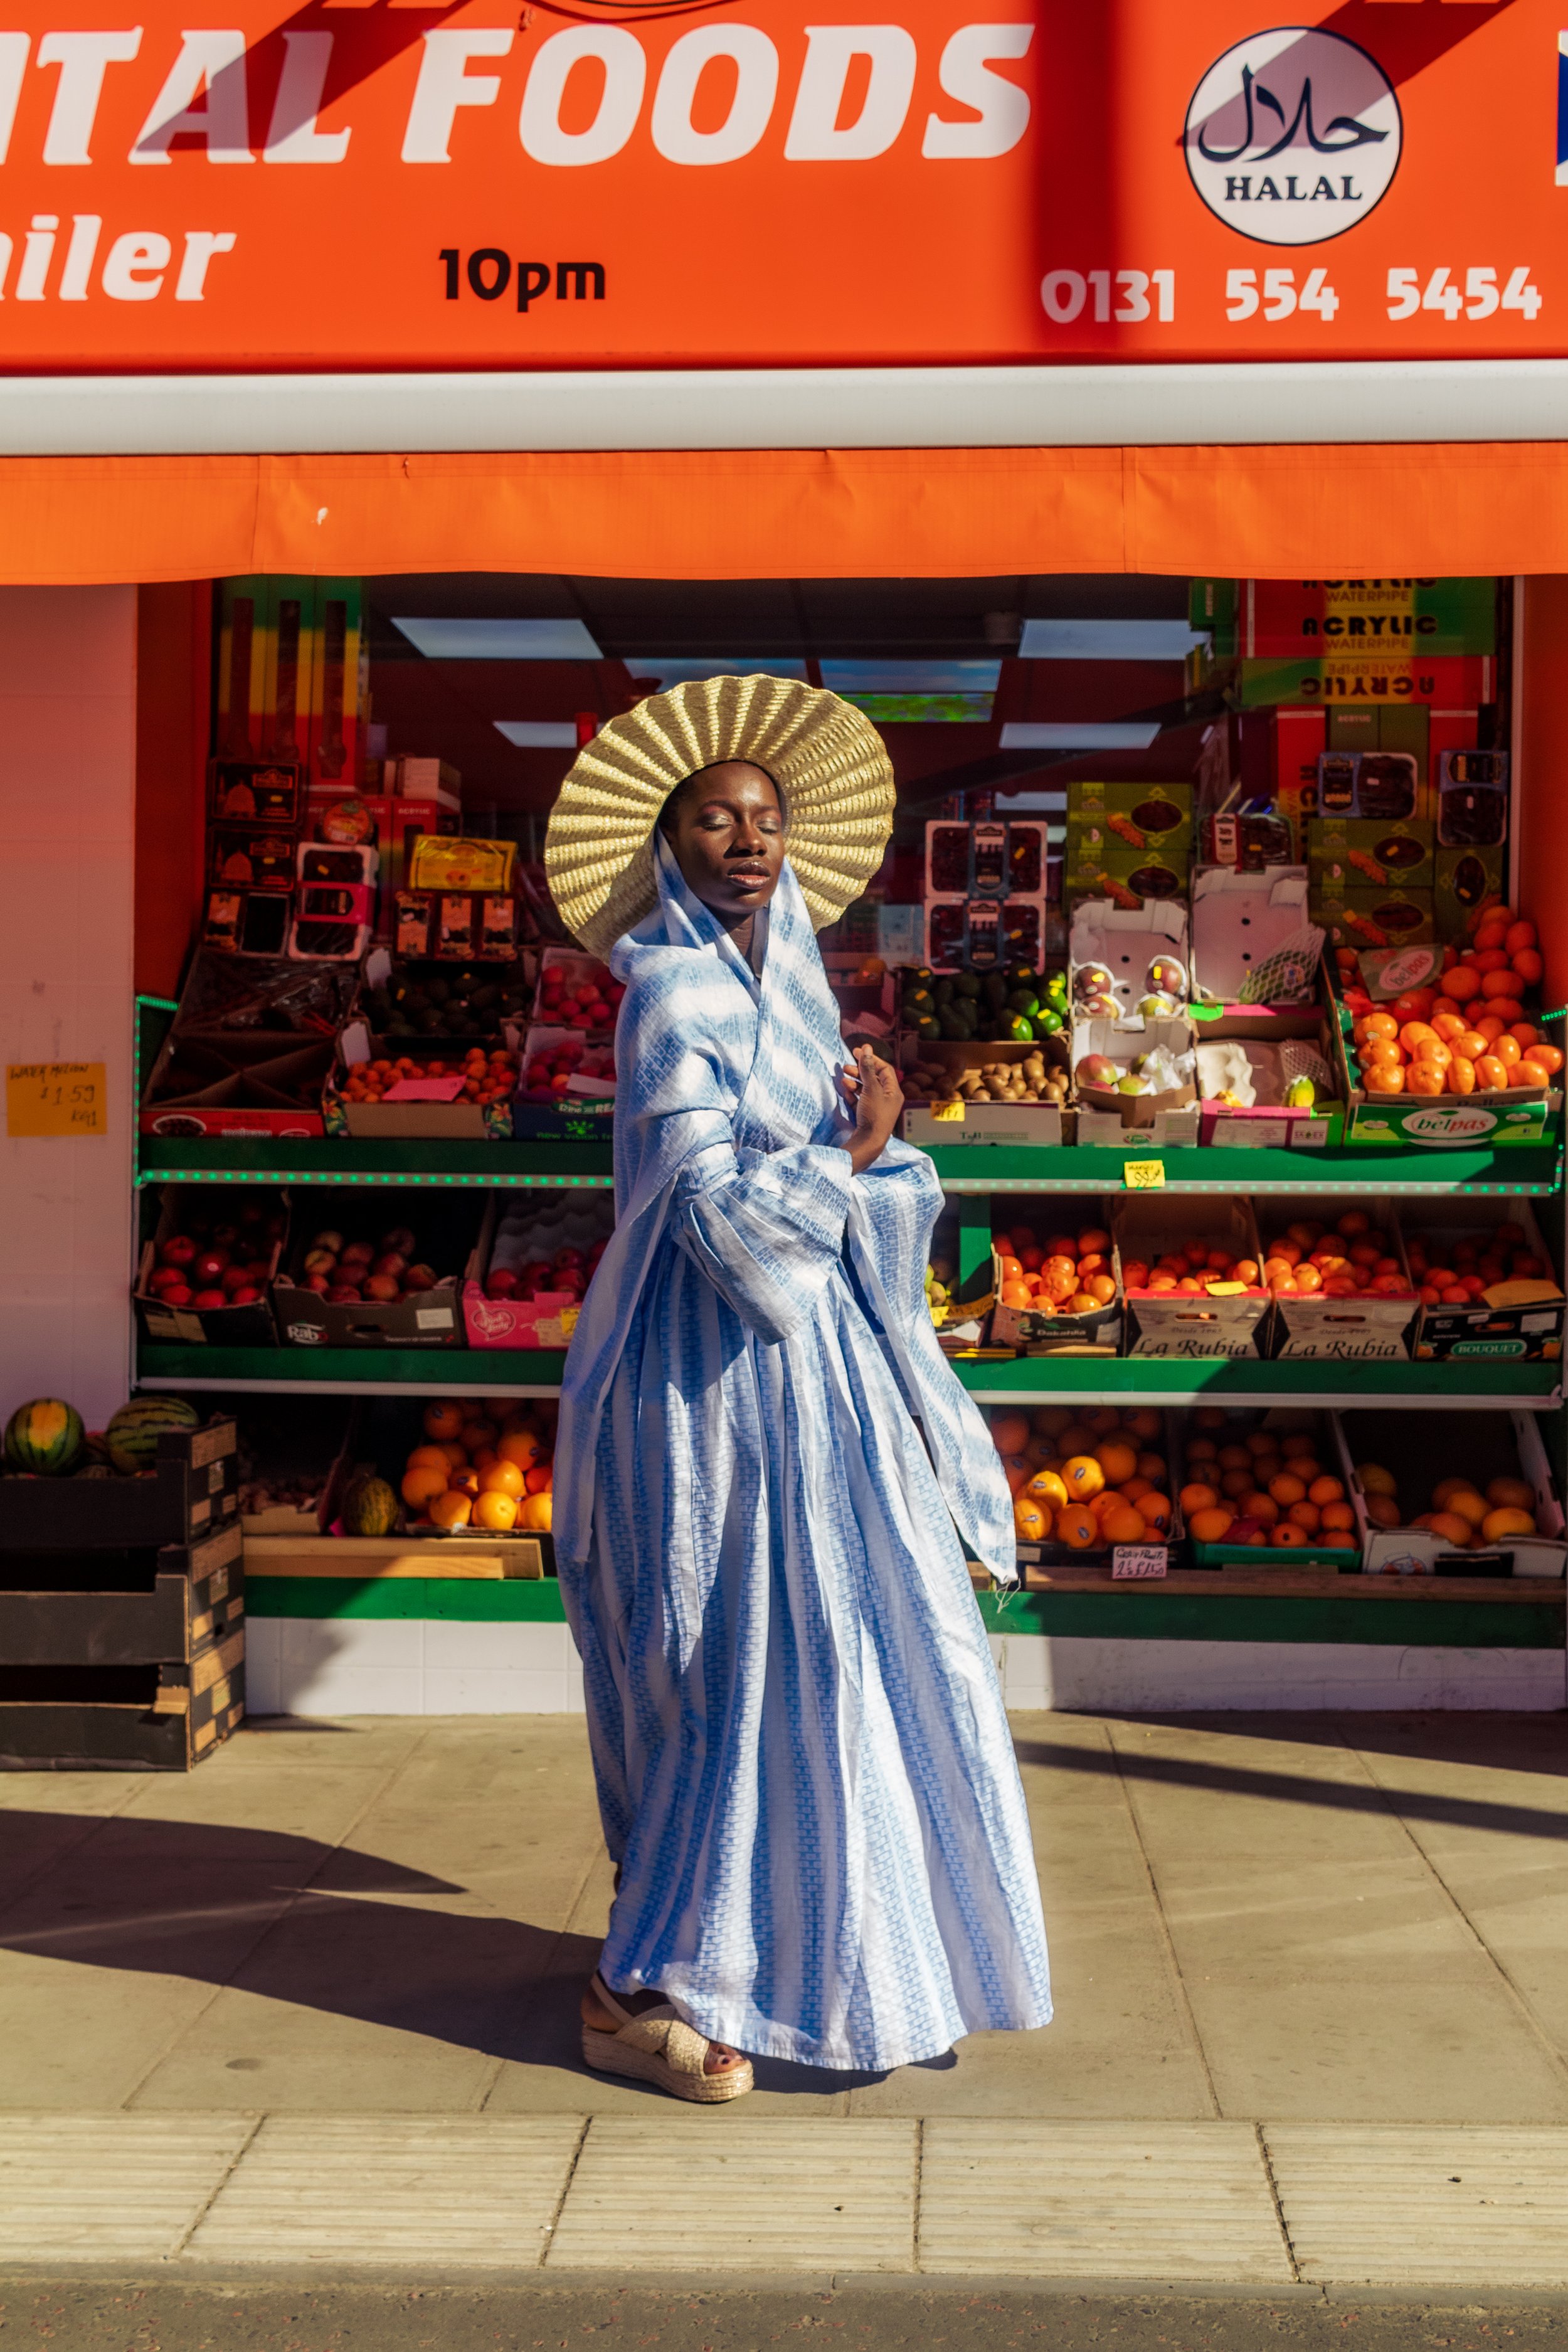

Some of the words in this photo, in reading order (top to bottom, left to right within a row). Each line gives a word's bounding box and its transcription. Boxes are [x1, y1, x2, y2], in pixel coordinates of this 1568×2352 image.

[400, 23, 1036, 167] FOODS
[1197, 63, 1391, 163] حلال
[1224, 176, 1363, 203] HALAL
[439, 248, 606, 313] 10pm
[1040, 269, 1175, 324] 0131
[1225, 268, 1340, 322] 554
[1386, 267, 1543, 320] 5454
[1325, 590, 1411, 603] WATERPIPE
[1301, 615, 1438, 636] ACRYLIC
[1325, 637, 1411, 650] WATERPIPE
[1328, 662, 1412, 674] WATERPIPE
[1299, 675, 1435, 696] ACRYLIC
[1416, 1117, 1489, 1134] belpas
[1175, 1337, 1249, 1359] Rubia
[1283, 1340, 1318, 1357] La
[1326, 1338, 1398, 1360] Rubia
[1458, 1344, 1518, 1354] BOUQUET
